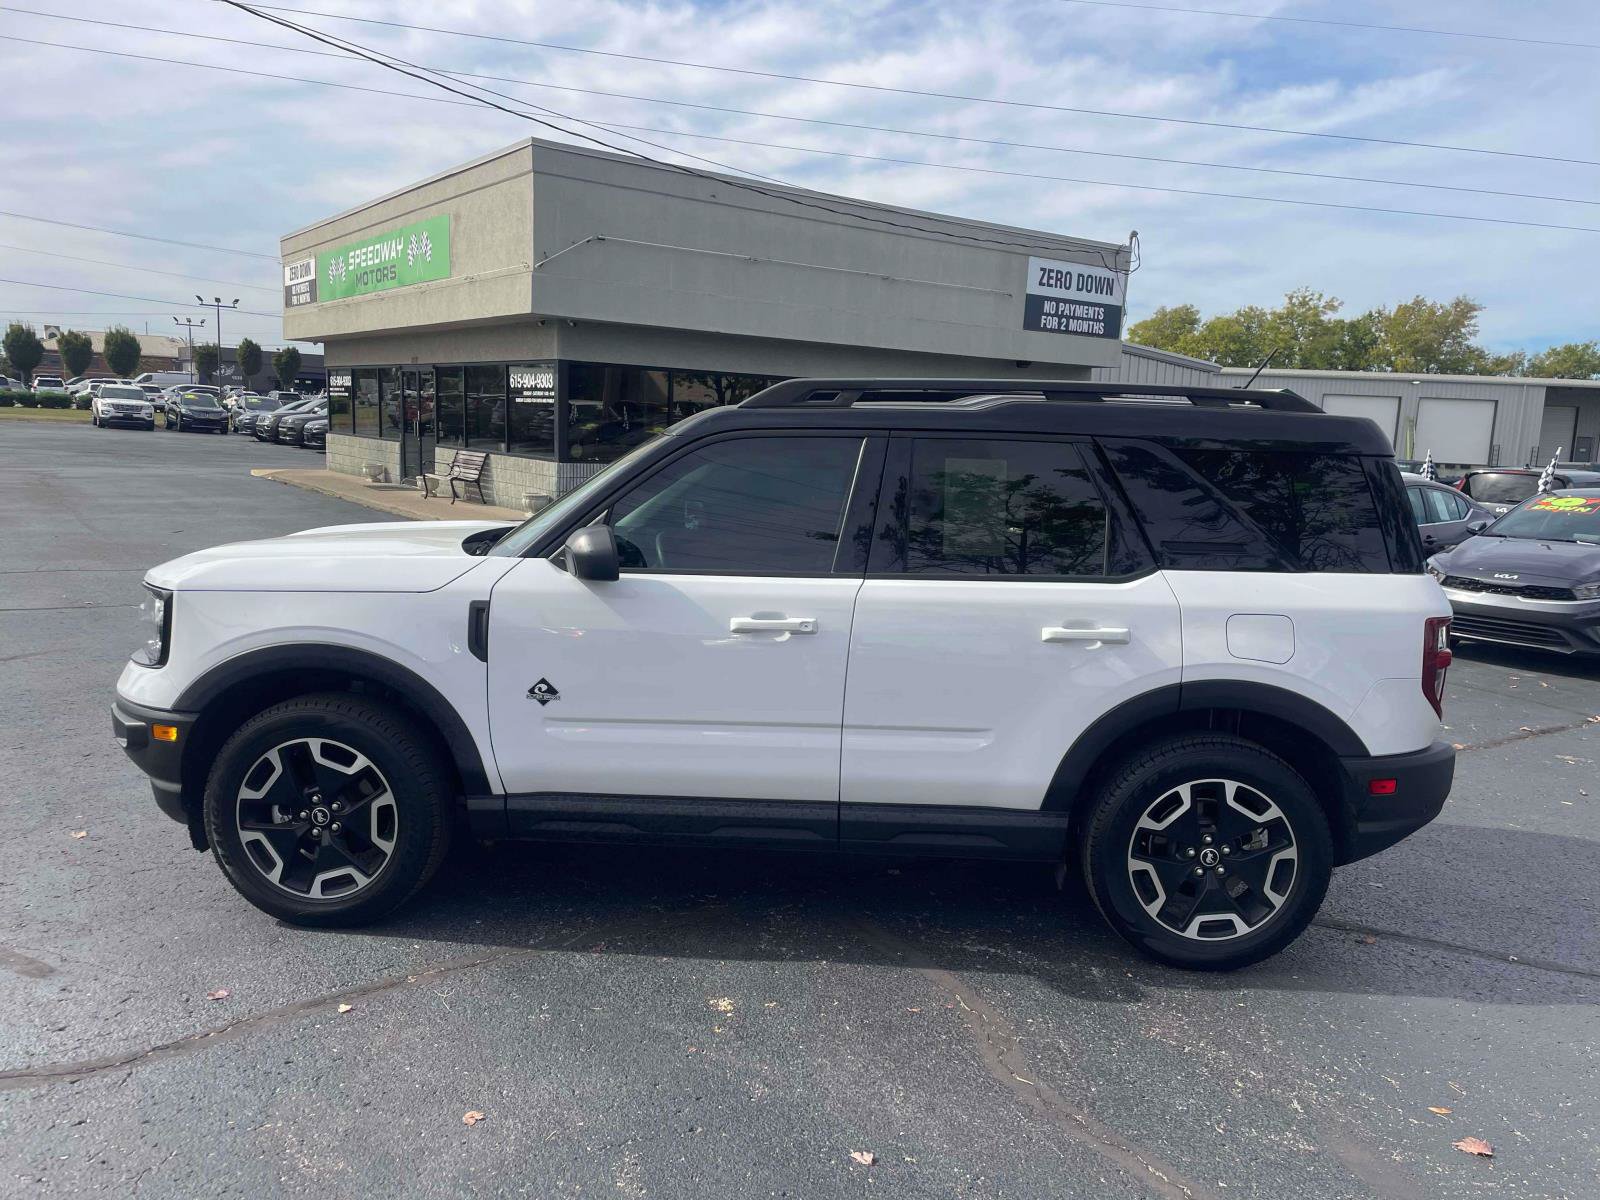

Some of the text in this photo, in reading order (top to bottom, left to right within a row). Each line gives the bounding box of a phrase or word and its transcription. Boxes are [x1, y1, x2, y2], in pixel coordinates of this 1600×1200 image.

[348, 235, 403, 270] SPEEDWAY
[355, 264, 397, 288] MOTORS
[1038, 267, 1115, 297] ZERO DOWN
[1043, 300, 1105, 320] NO PAYMENTS
[1040, 315, 1105, 335] FOR 2 MONTHS
[510, 373, 554, 389] 615-904-9303
